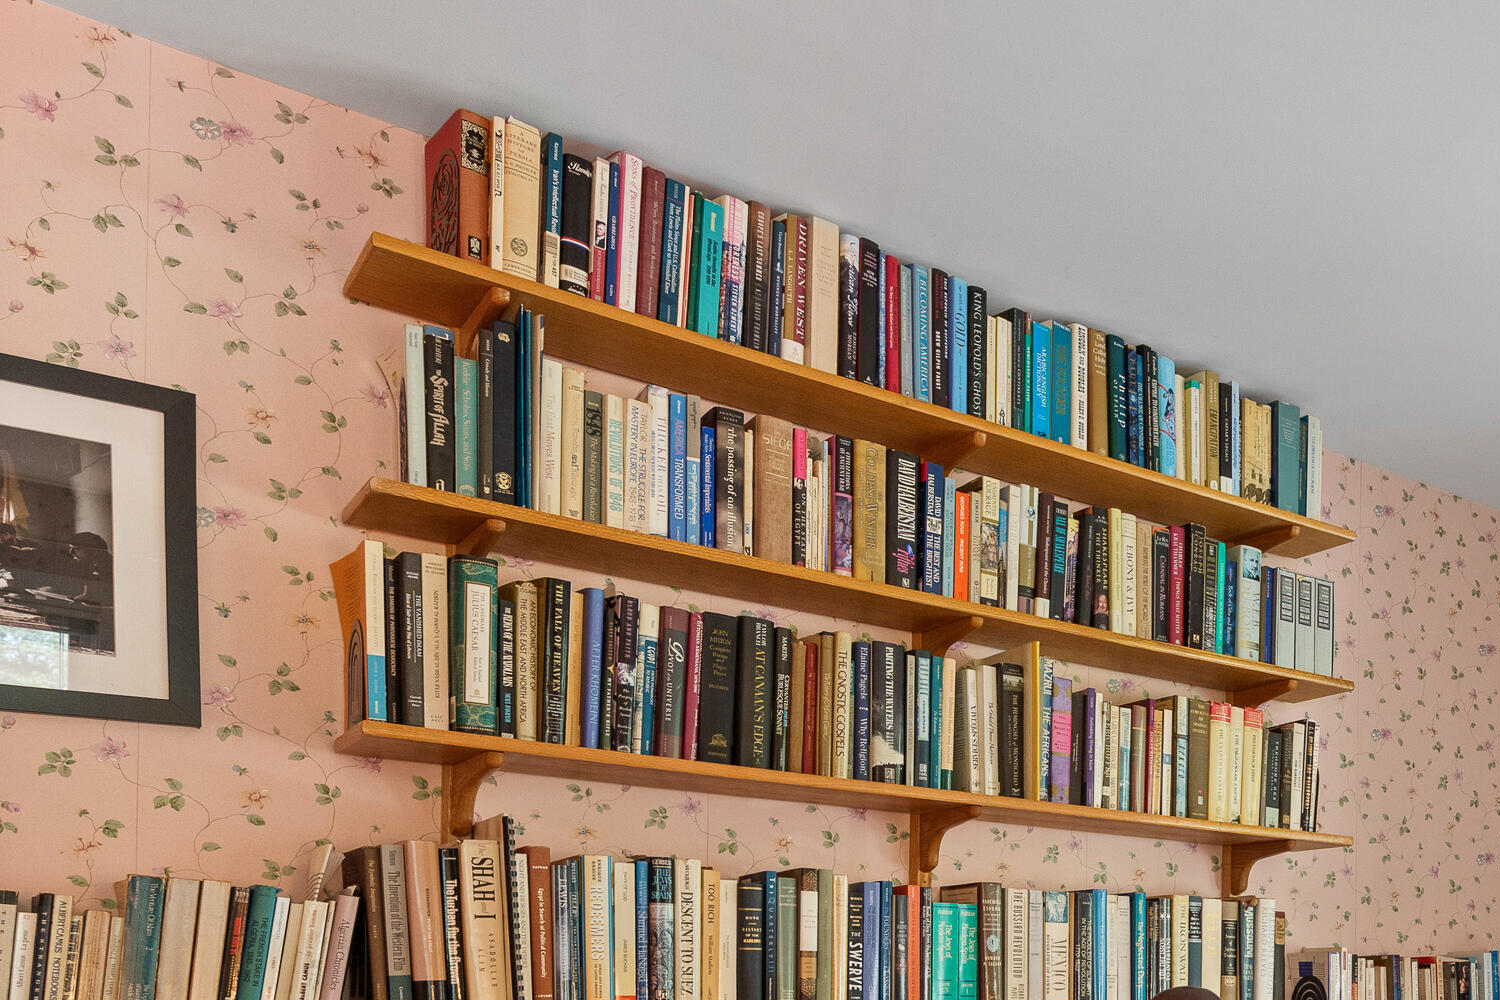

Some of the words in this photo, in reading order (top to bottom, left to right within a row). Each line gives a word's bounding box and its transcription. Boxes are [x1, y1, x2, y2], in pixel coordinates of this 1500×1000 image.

[628, 190, 638, 240] PROVIDENCE
[797, 224, 806, 287] DRIVEN
[796, 294, 805, 340] WEST
[919, 279, 927, 343] BECOMING
[974, 292, 982, 320] KING
[955, 313, 966, 347] GOLD
[973, 323, 982, 377] LEOPOLD'S
[920, 346, 928, 392] AMERICA
[973, 381, 981, 417] GHOST
[428, 412, 449, 446] ALLAH
[586, 407, 601, 437] 1848
[675, 418, 683, 455] AMERICA
[1209, 409, 1218, 458] EMANCIPATION
[609, 418, 622, 473] REVOLUTIONS
[631, 443, 638, 451] IN
[610, 477, 622, 488] OF
[630, 452, 638, 482] EUROPE
[724, 446, 737, 484] passing
[866, 448, 878, 502] COLDEST
[898, 458, 916, 488] DAVID
[610, 492, 622, 511] 1848
[638, 464, 646, 503] STRUGGLE
[675, 458, 683, 519] TRANSFORMED
[728, 485, 738, 498] of
[927, 474, 935, 516] HALBERSTAM
[728, 496, 736, 509] an
[897, 487, 915, 542] HALBERSTAM
[727, 512, 736, 547] illusion
[866, 504, 878, 550] WINTER
[1126, 545, 1134, 582] EBONY
[530, 601, 536, 611] AN
[555, 584, 563, 605] THE
[1126, 585, 1134, 593] &
[1126, 597, 1134, 615] IVY
[555, 608, 563, 632] FALL
[554, 636, 562, 649] OF
[592, 640, 601, 672] AFTER
[756, 647, 764, 664] AT
[838, 651, 847, 669] THE
[860, 647, 868, 672] Elaine
[553, 652, 561, 692] HEAVEN
[859, 674, 867, 699] Pagels
[1044, 658, 1052, 695] MAZRUI
[590, 674, 600, 725] KHOMEINI
[754, 665, 765, 722] CANAAN'S
[837, 671, 847, 713] GNOSTIC
[859, 718, 867, 736] Why
[1043, 706, 1051, 727] THE
[753, 725, 764, 757] EDGE
[836, 715, 846, 756] GOSPELS
[1042, 731, 1050, 776] AFRICANS
[859, 738, 867, 776] Religion?
[471, 857, 495, 901] SHAH
[57, 900, 67, 929] ALBERT
[590, 886, 605, 961] REDEEMERS
[681, 892, 693, 945] DESCENT
[55, 929, 65, 953] CAMUS
[336, 919, 349, 950] Algerian
[329, 951, 345, 991] Chronicles
[681, 948, 693, 962] TO
[849, 942, 862, 991] SWERVE
[1051, 939, 1067, 991] MEXICO
[49, 957, 60, 1000] NOTEBOOKS
[681, 966, 693, 996] SUEZ
